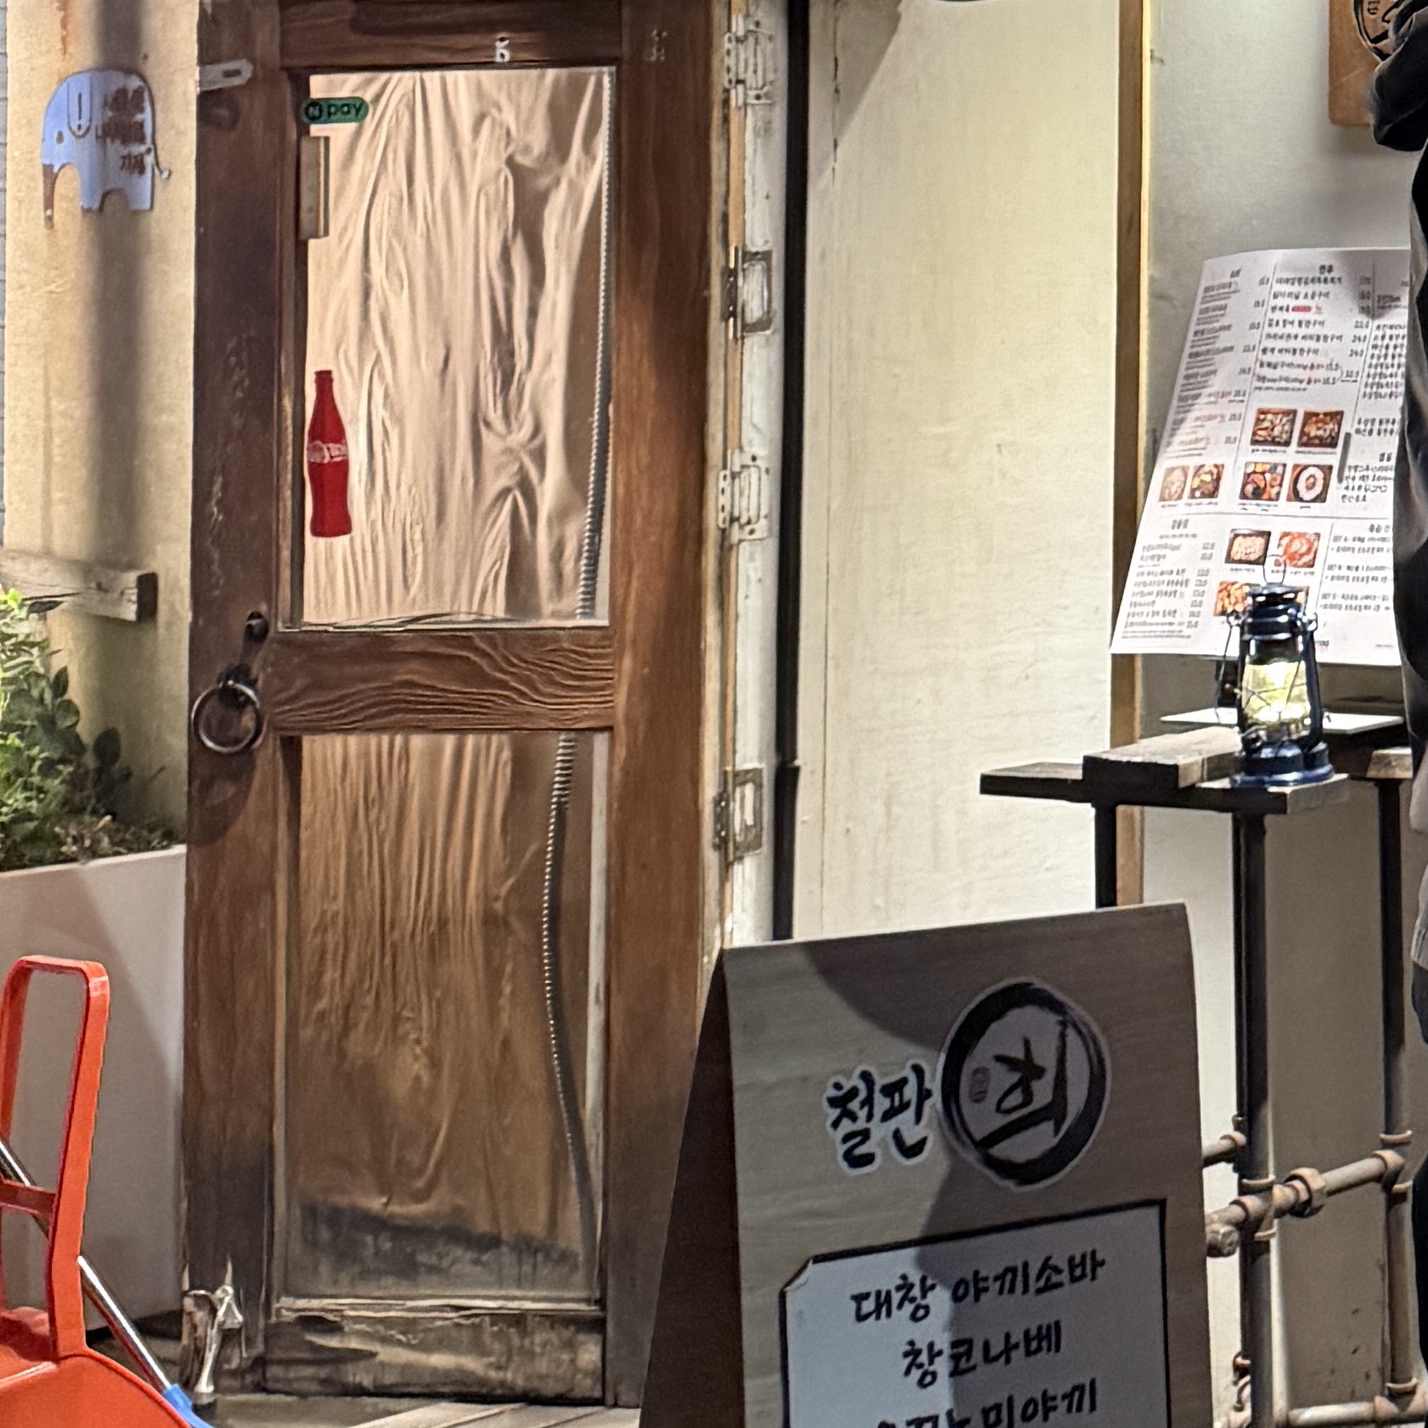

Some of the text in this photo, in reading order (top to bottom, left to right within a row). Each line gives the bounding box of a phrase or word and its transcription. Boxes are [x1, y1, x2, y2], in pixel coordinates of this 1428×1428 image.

[825, 1064, 933, 1170] 철판
[850, 1249, 1106, 1323] 대창 야끼소바
[903, 1319, 1063, 1390] 창코나베
